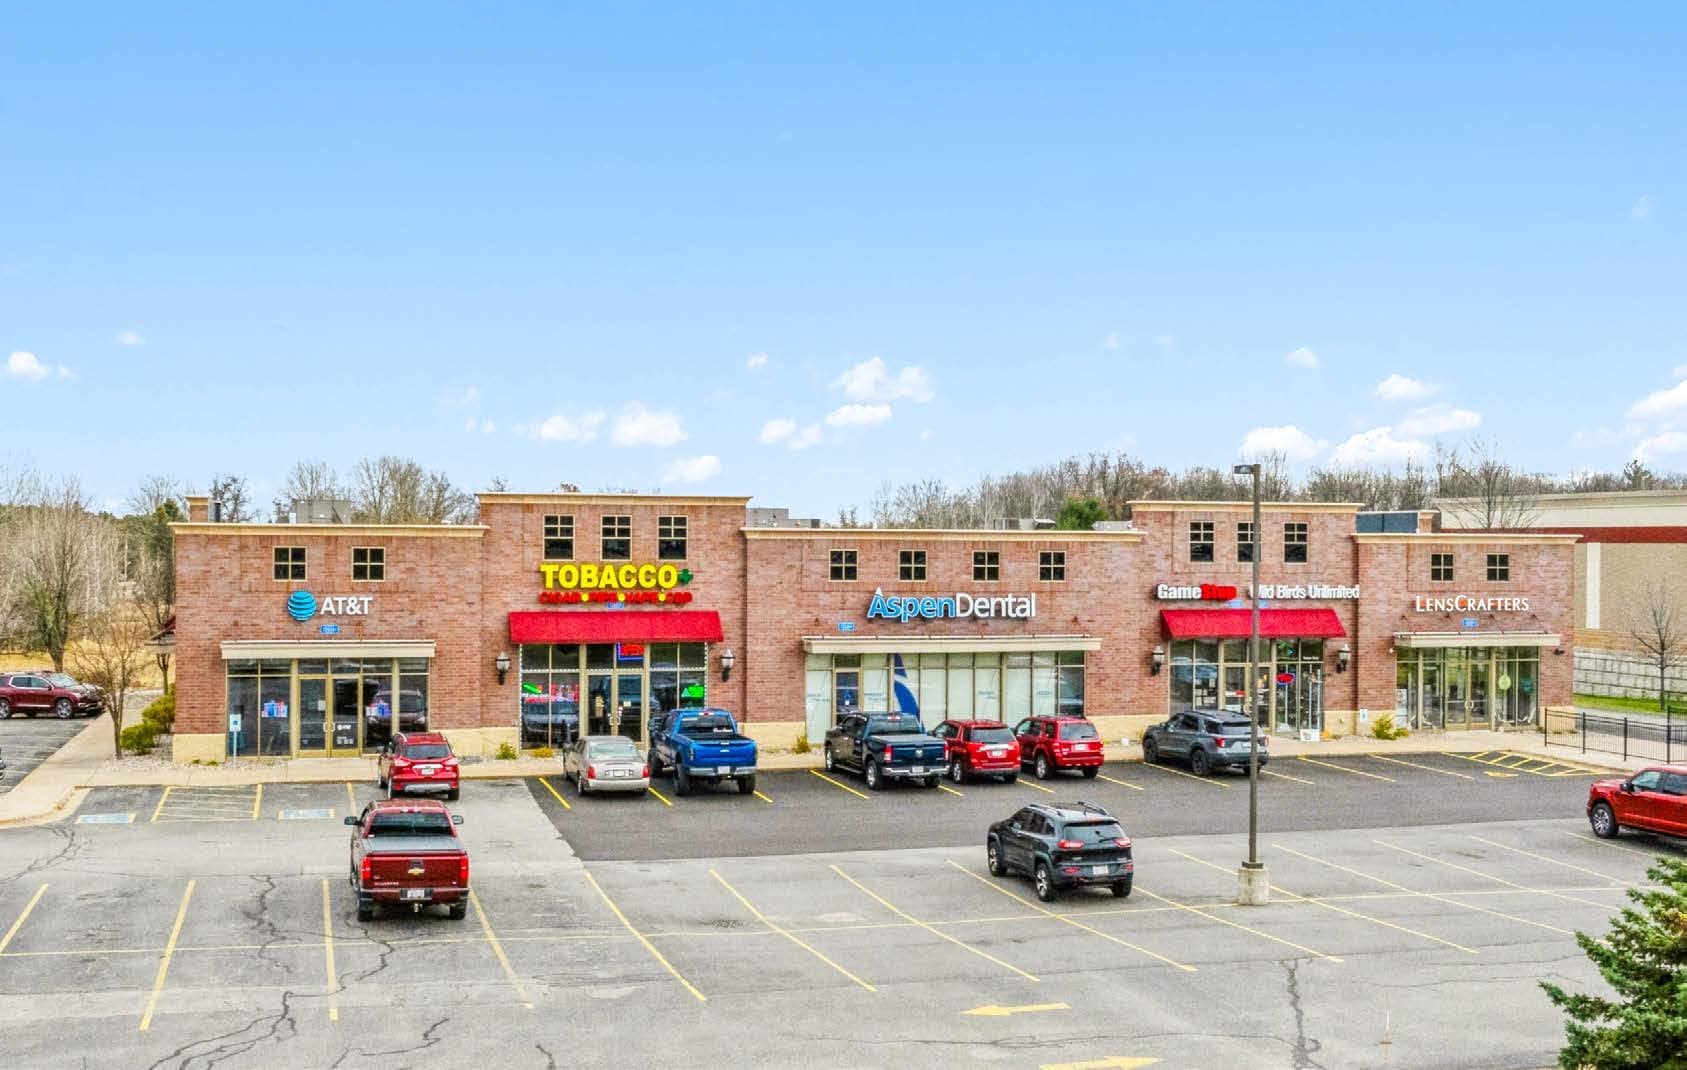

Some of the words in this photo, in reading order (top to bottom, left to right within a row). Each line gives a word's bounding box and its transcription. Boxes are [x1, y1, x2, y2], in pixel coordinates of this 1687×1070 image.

[1276, 583, 1306, 600] Birds
[1308, 583, 1360, 600] Unlimited
[320, 596, 374, 615] AT&T
